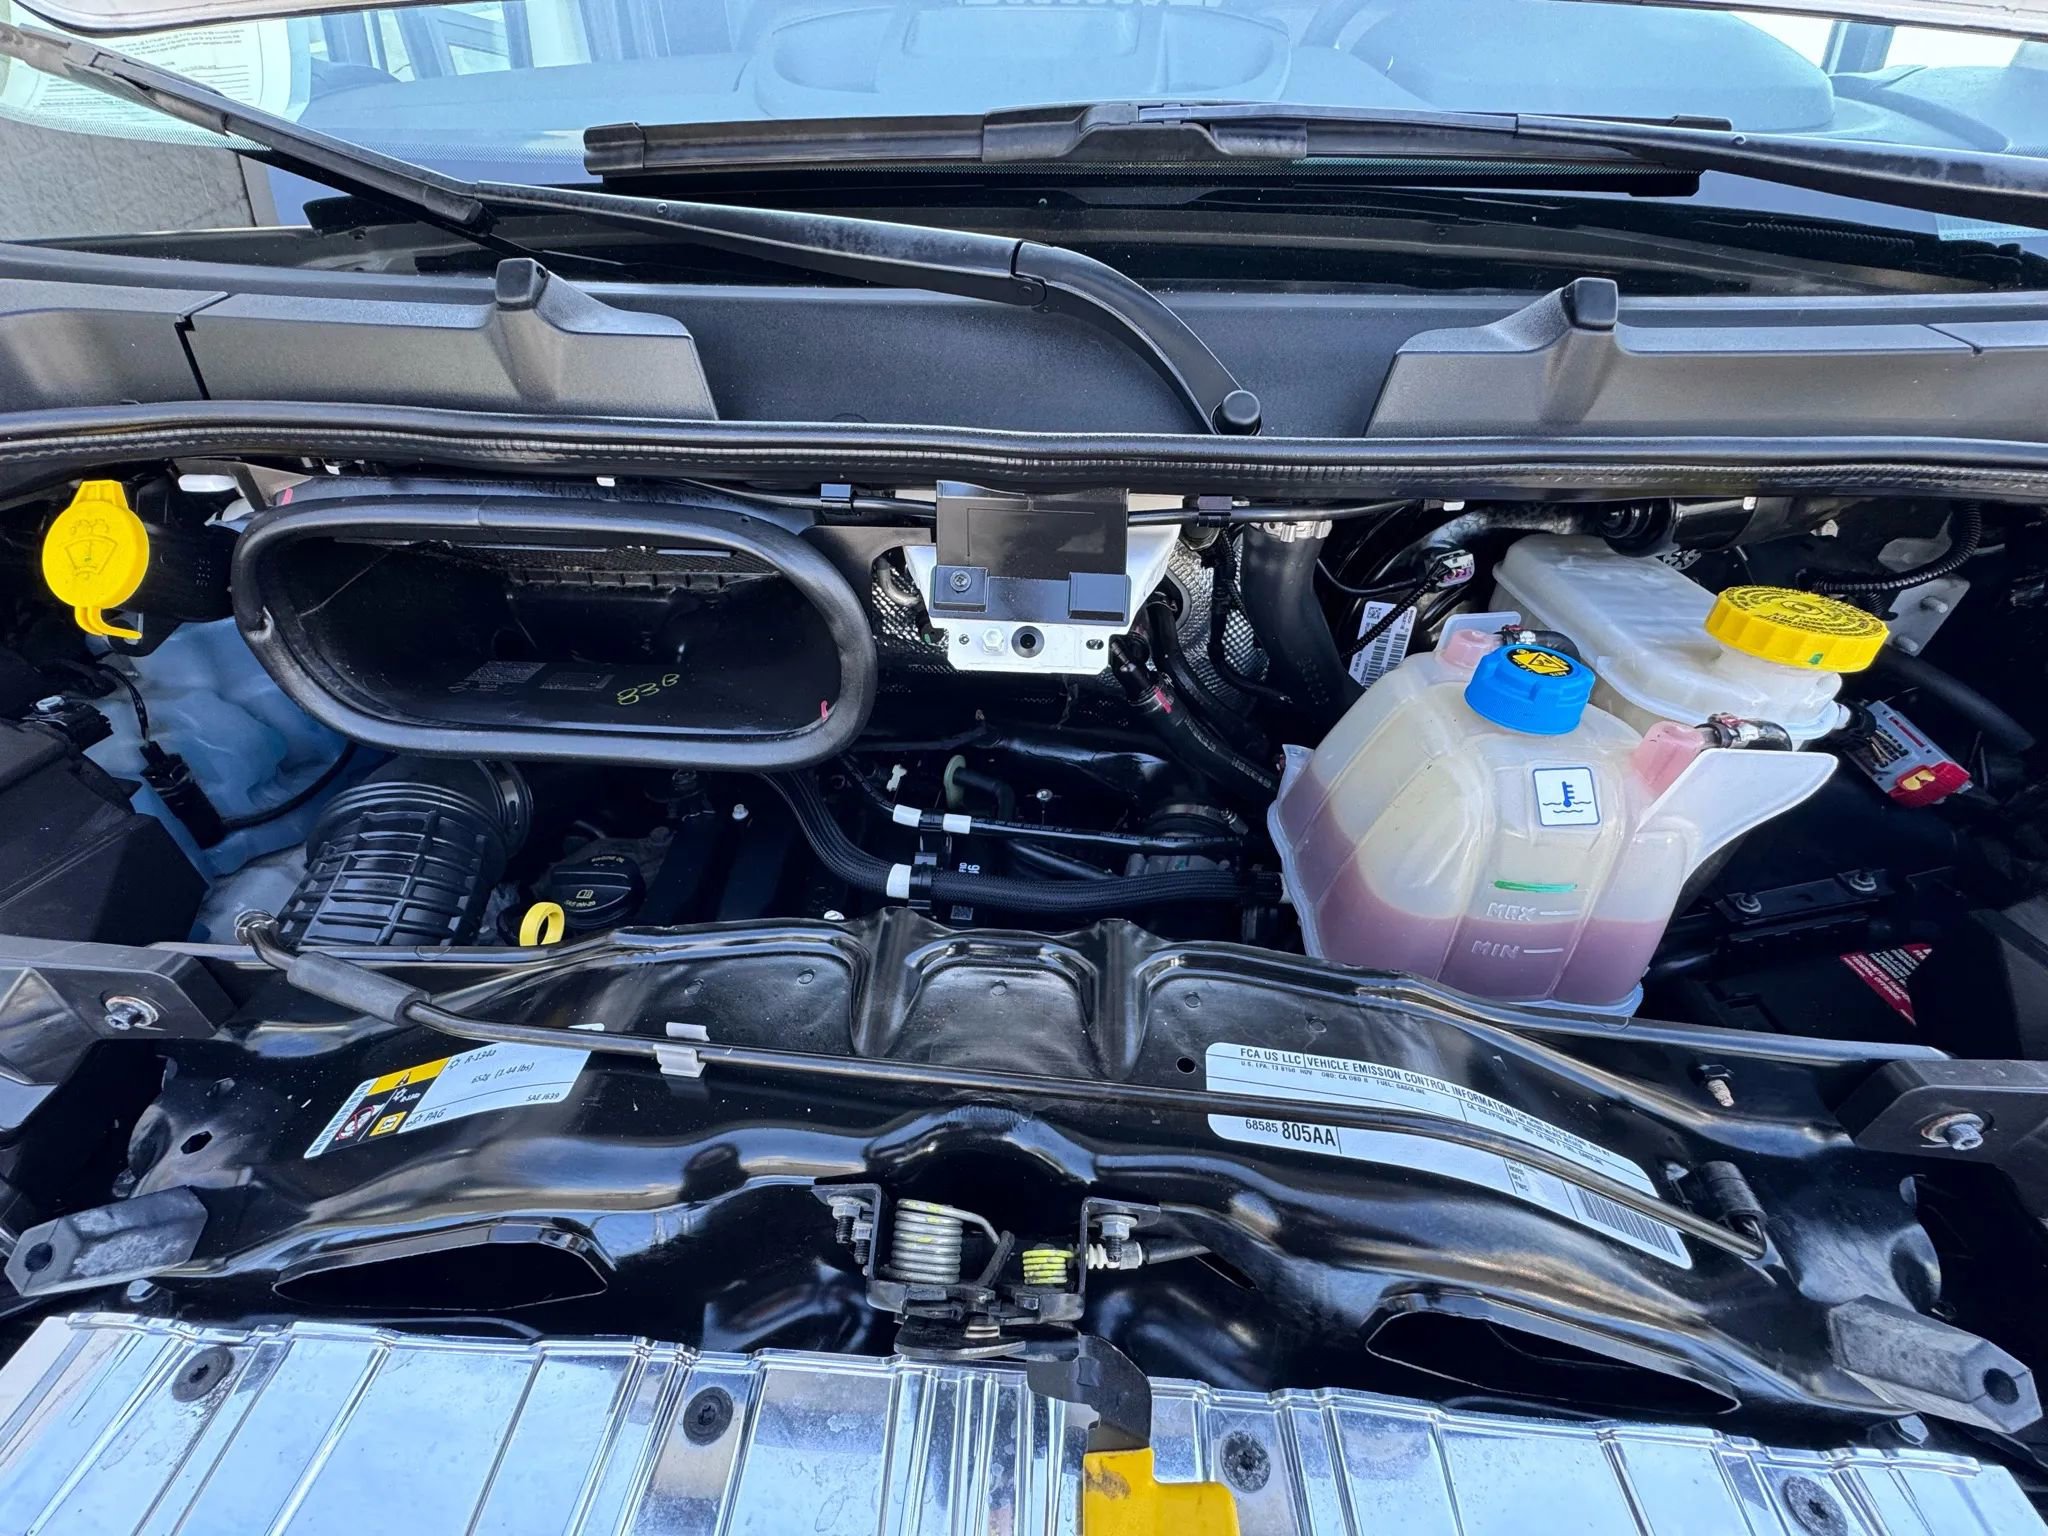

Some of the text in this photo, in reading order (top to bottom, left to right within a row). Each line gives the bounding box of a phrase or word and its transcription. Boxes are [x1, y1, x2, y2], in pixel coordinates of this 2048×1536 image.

[1486, 902, 1537, 921] MAX
[1471, 940, 1520, 959] MIN
[1240, 1047, 1302, 1065] FCA US LLC
[1306, 1056, 1512, 1118] VEHICLE EMISSION CONTROL INFORMATION
[424, 1108, 447, 1122] PAG
[1245, 1119, 1336, 1146] 68585 805AA
